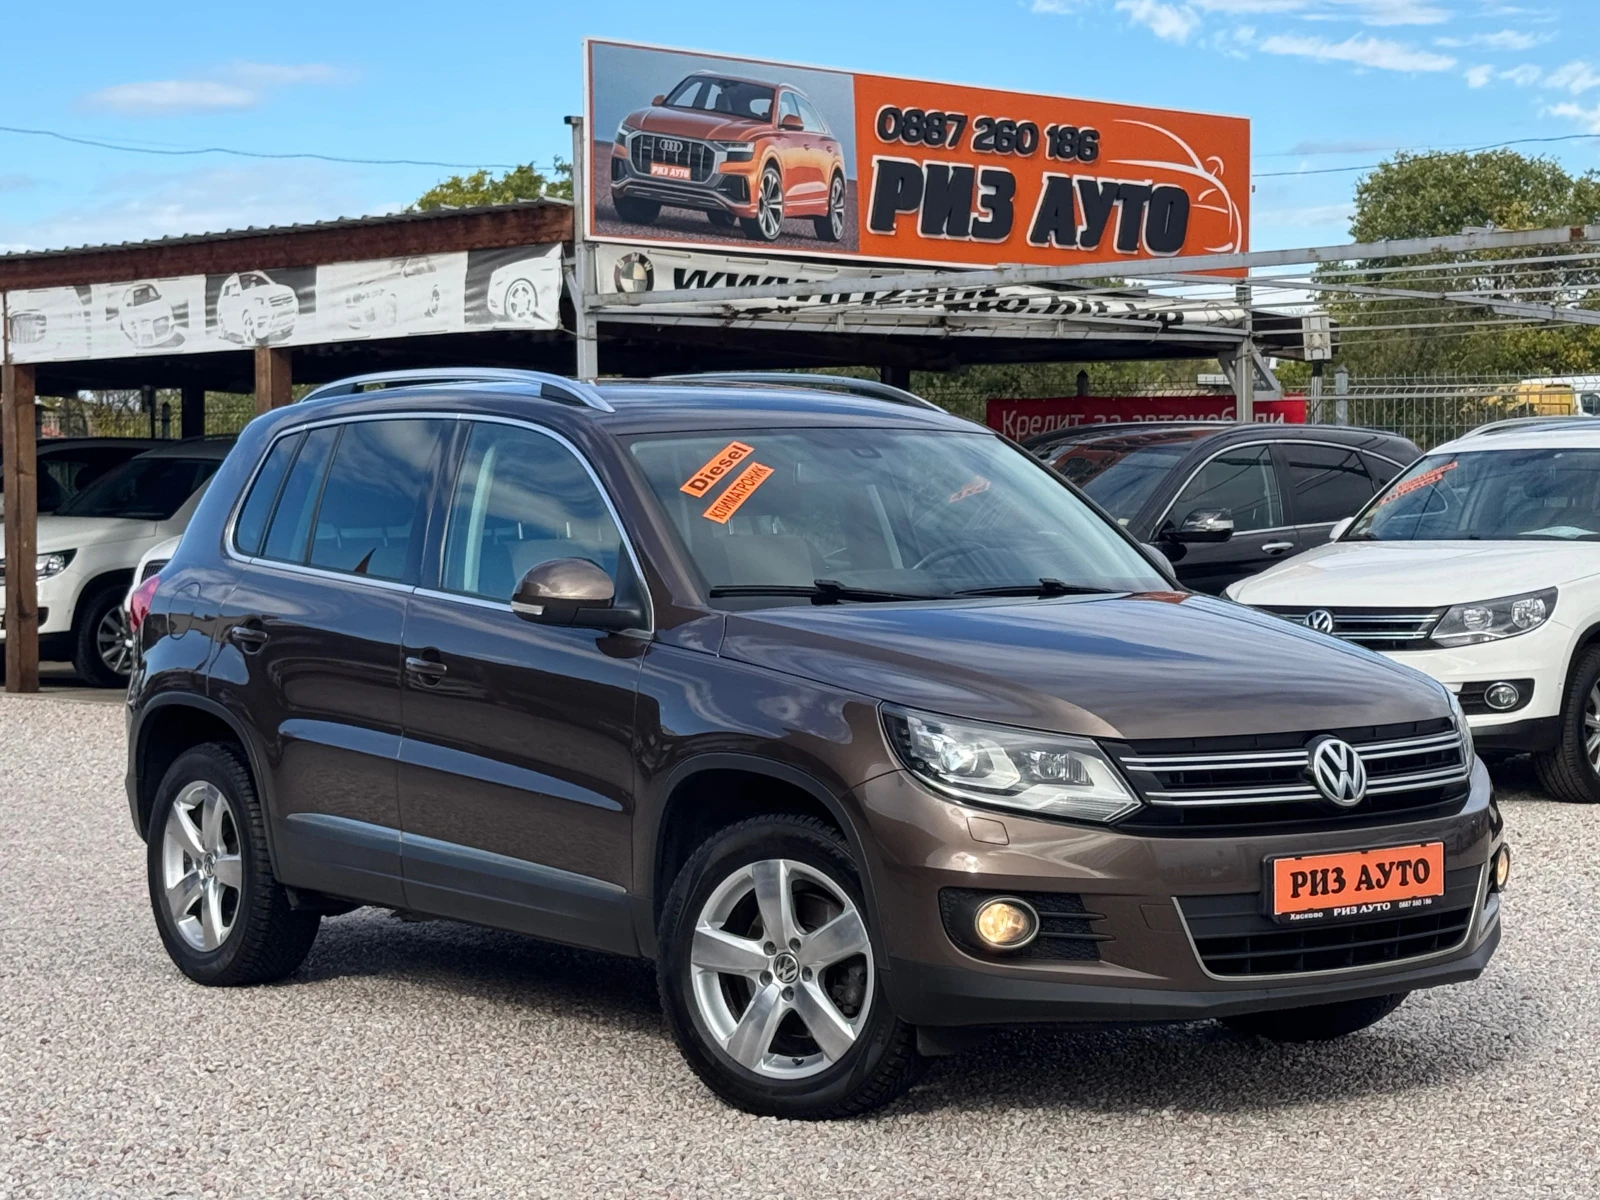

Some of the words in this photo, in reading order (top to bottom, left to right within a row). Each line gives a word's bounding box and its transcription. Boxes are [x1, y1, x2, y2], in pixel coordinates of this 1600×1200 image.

[875, 104, 968, 150] 0887
[970, 115, 1040, 158] 260
[1044, 123, 1100, 164] 186
[651, 165, 668, 176] РИЗ
[670, 167, 690, 178] АУТО
[866, 155, 1017, 242] РИЗ
[1026, 171, 1190, 257] АУТО
[1002, 409, 1085, 441] Кредит
[687, 444, 749, 492] Diesel
[708, 465, 769, 520] КЛИМАТРОНИК
[1314, 739, 1366, 806] VW
[1289, 866, 1346, 898] РИЗ
[1354, 858, 1431, 892] АУТО
[1289, 910, 1324, 921] Хасково
[1333, 906, 1358, 917] РИЗ
[1359, 902, 1391, 914] АУТО
